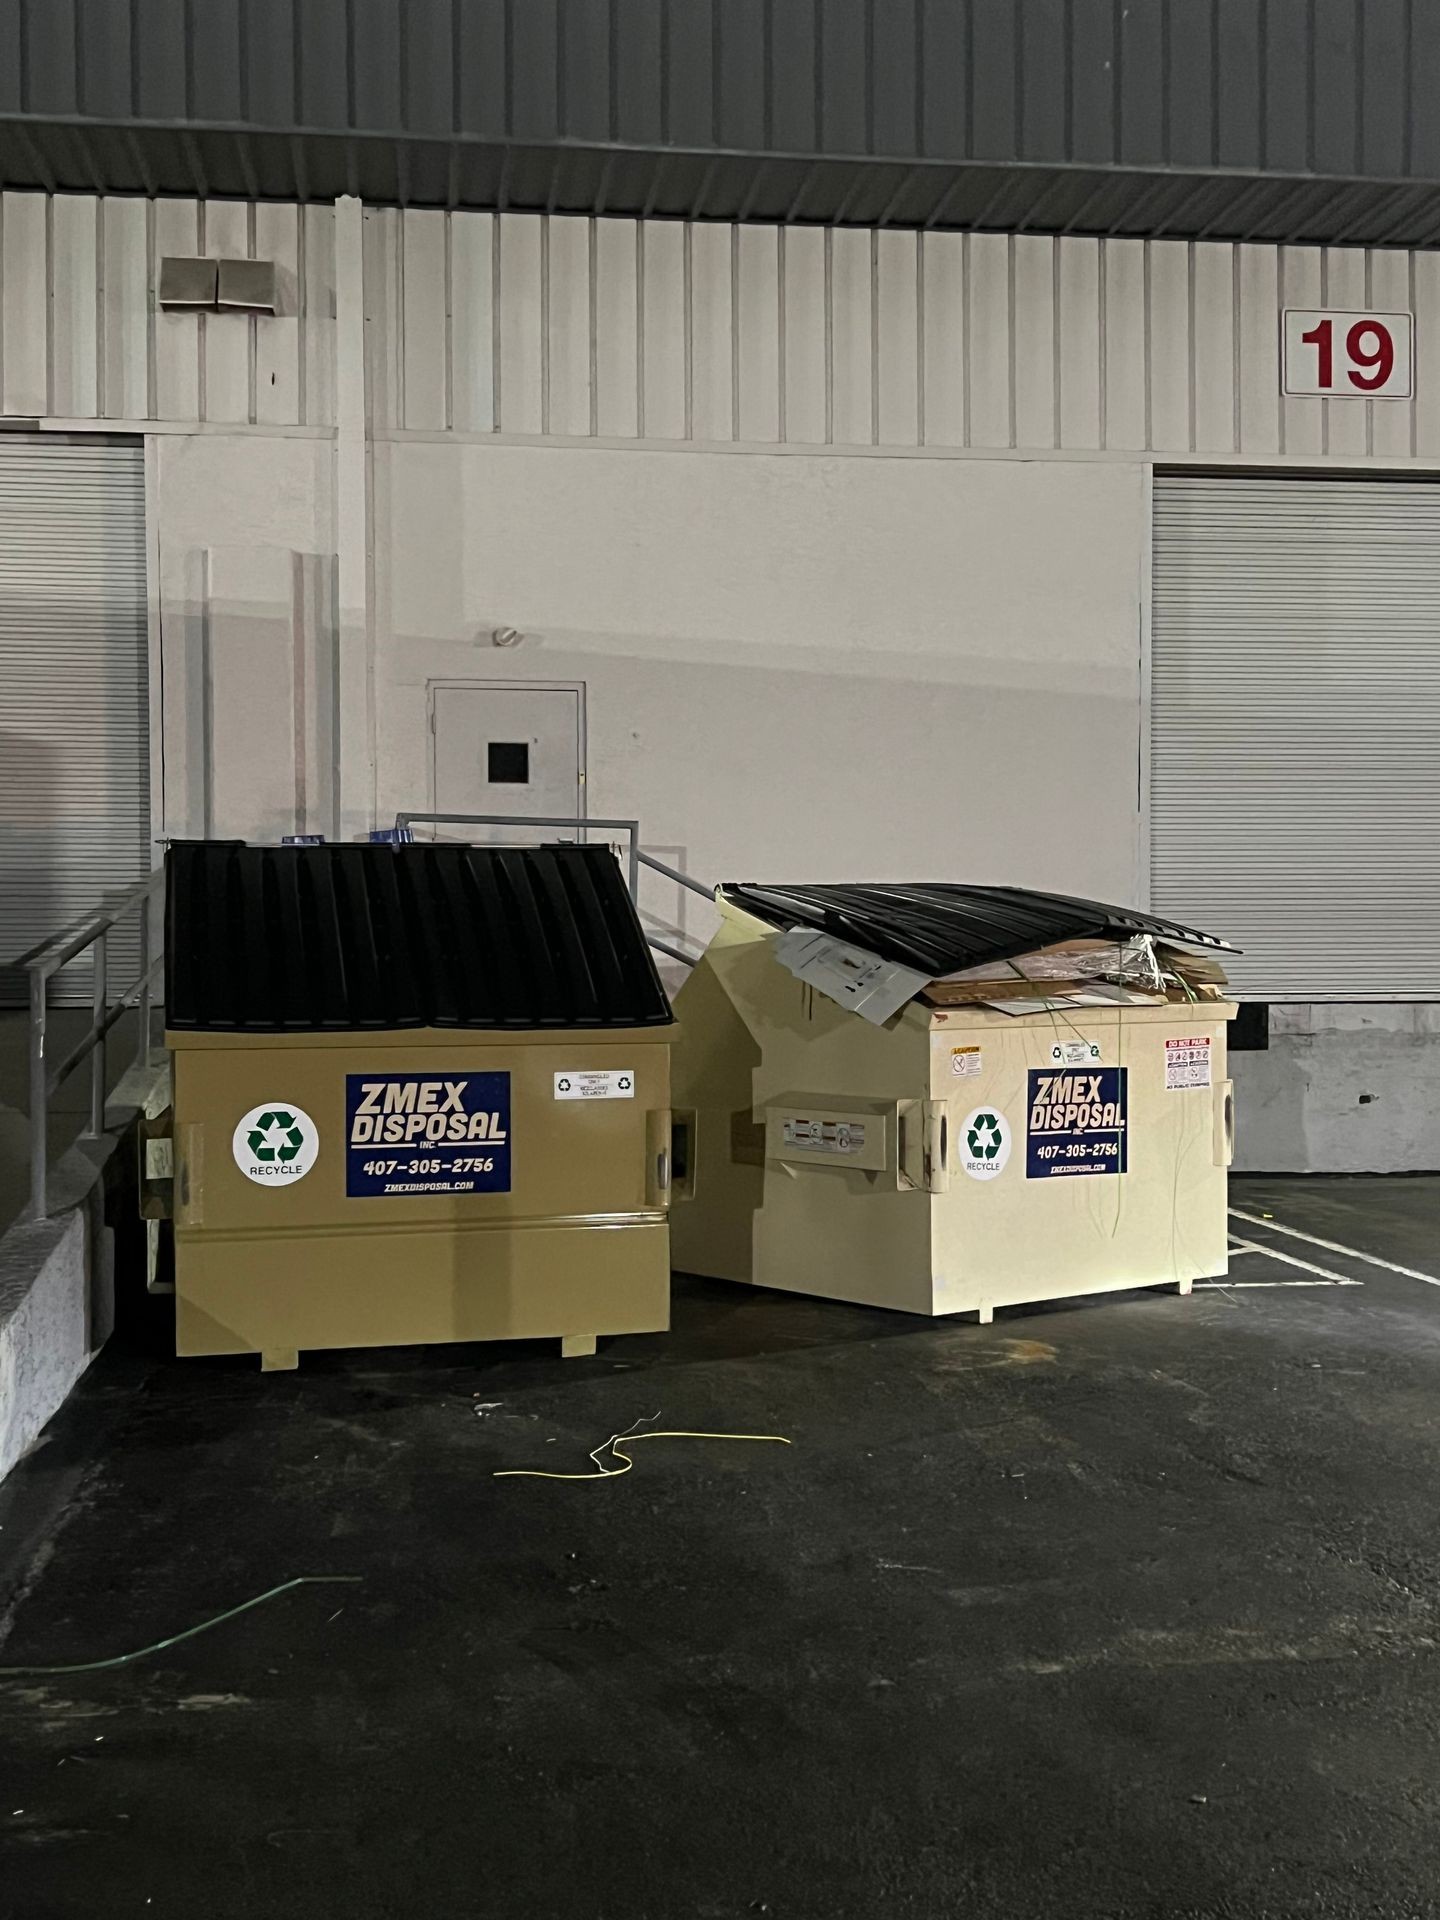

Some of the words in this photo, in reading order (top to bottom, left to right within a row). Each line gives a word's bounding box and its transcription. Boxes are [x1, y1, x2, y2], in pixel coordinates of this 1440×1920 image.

[1302, 319, 1394, 391] 19
[355, 1081, 468, 1115] ZMEX
[1033, 1075, 1103, 1105] ZMEX
[351, 1112, 507, 1142] DISPOSAL
[1030, 1102, 1125, 1130] DISPOSAL
[1037, 1143, 1118, 1159] 407-305-2756
[250, 1165, 303, 1175] RECYCLE
[363, 1158, 494, 1175] 407-305-2756
[966, 1162, 1000, 1171] RECYCLE
[384, 1181, 474, 1193] ZMEXDISPOSAL.COM
